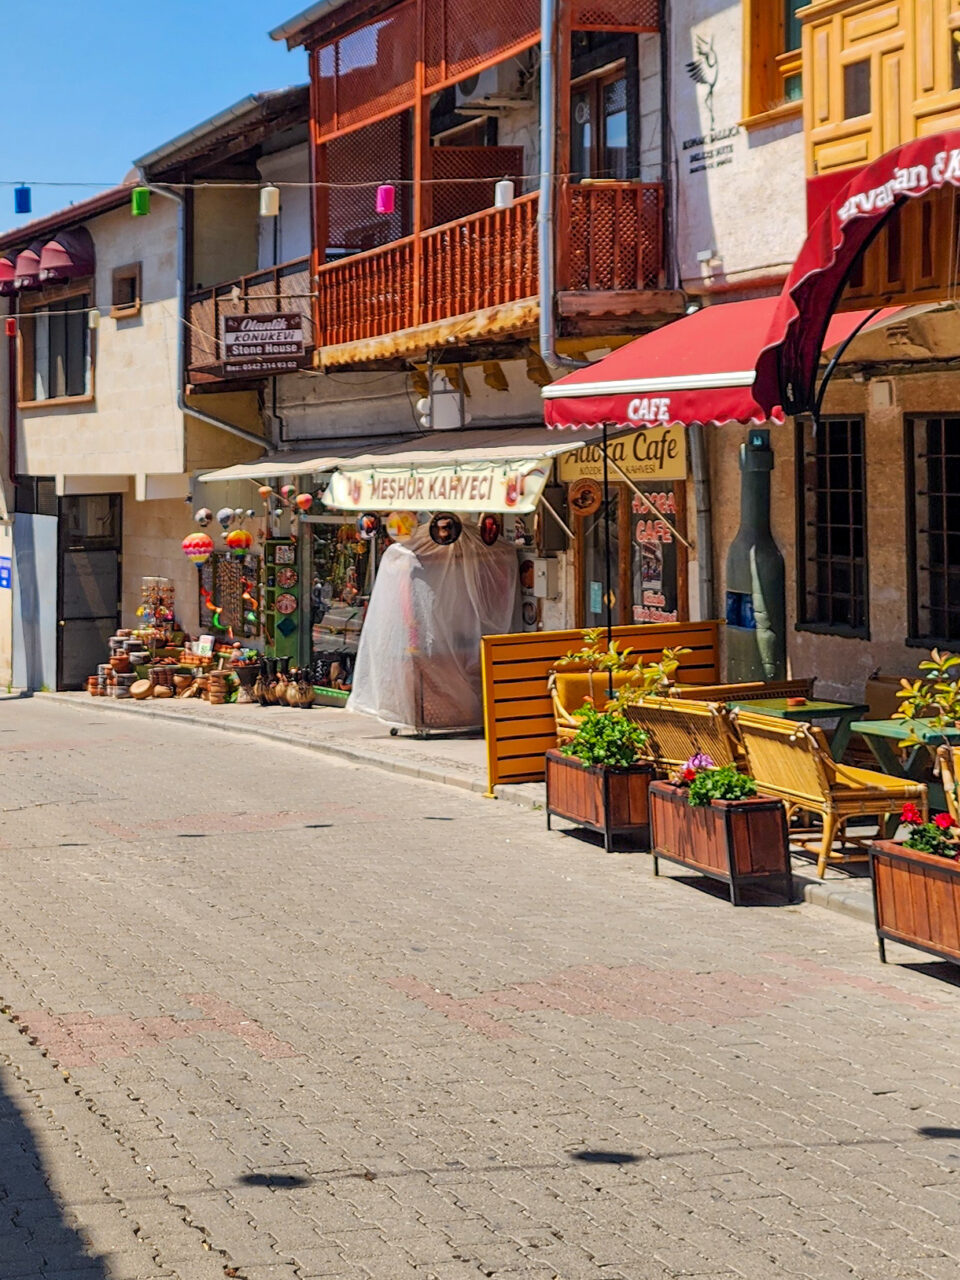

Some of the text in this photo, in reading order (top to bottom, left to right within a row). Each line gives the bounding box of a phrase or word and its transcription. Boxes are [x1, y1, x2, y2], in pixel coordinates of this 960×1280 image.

[232, 343, 298, 355] Stone House
[627, 398, 671, 421] CAFE
[633, 430, 679, 470] Cafe
[428, 468, 495, 500] KAHVECİ
[636, 520, 672, 543] CAFE
